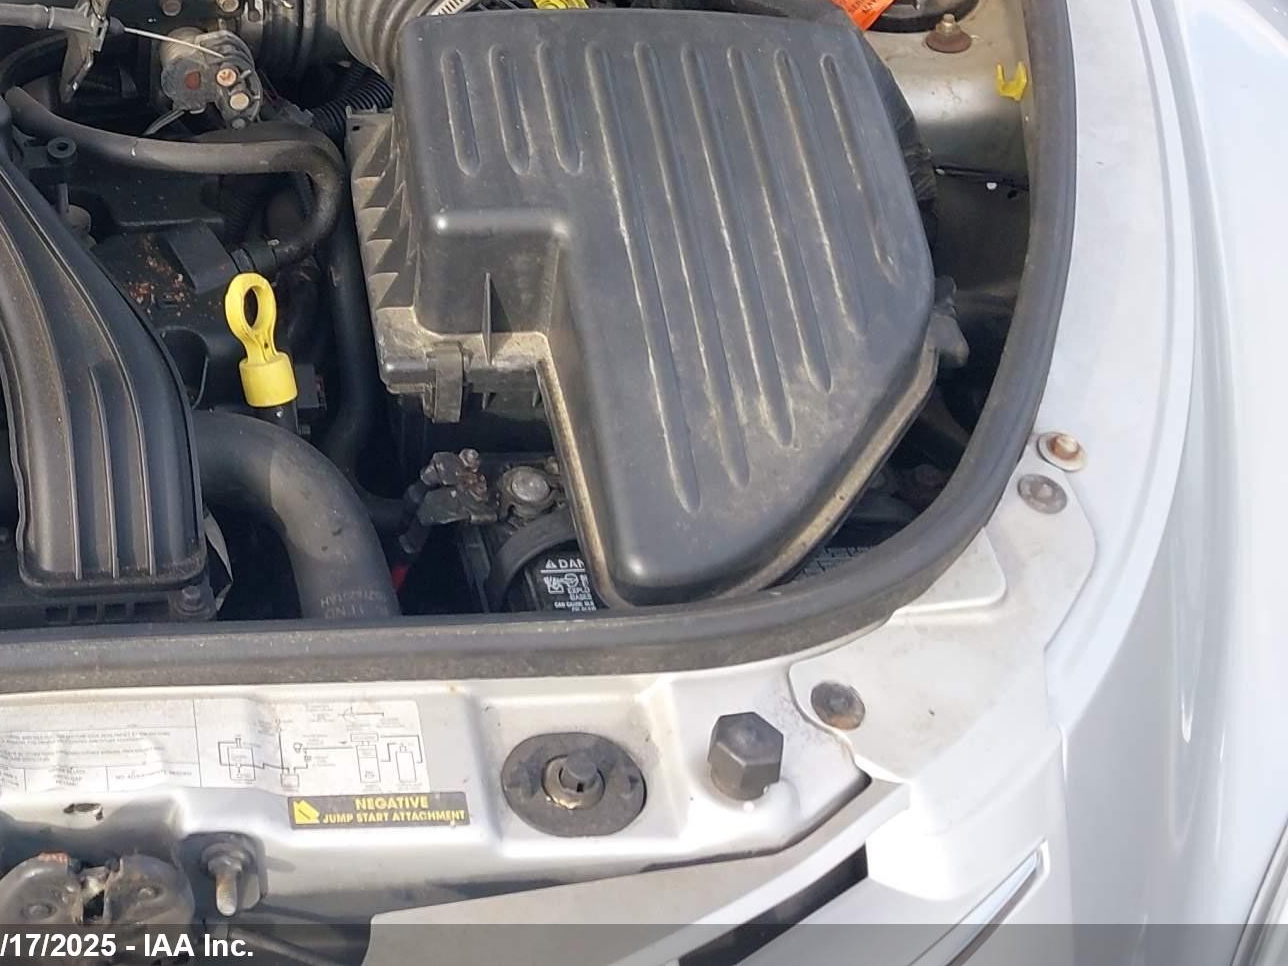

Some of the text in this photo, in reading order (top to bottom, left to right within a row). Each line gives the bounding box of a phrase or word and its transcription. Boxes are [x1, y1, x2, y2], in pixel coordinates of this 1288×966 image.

[354, 795, 430, 811] NEGATIVE
[322, 809, 466, 824] JUMP START ATTACHMENT
